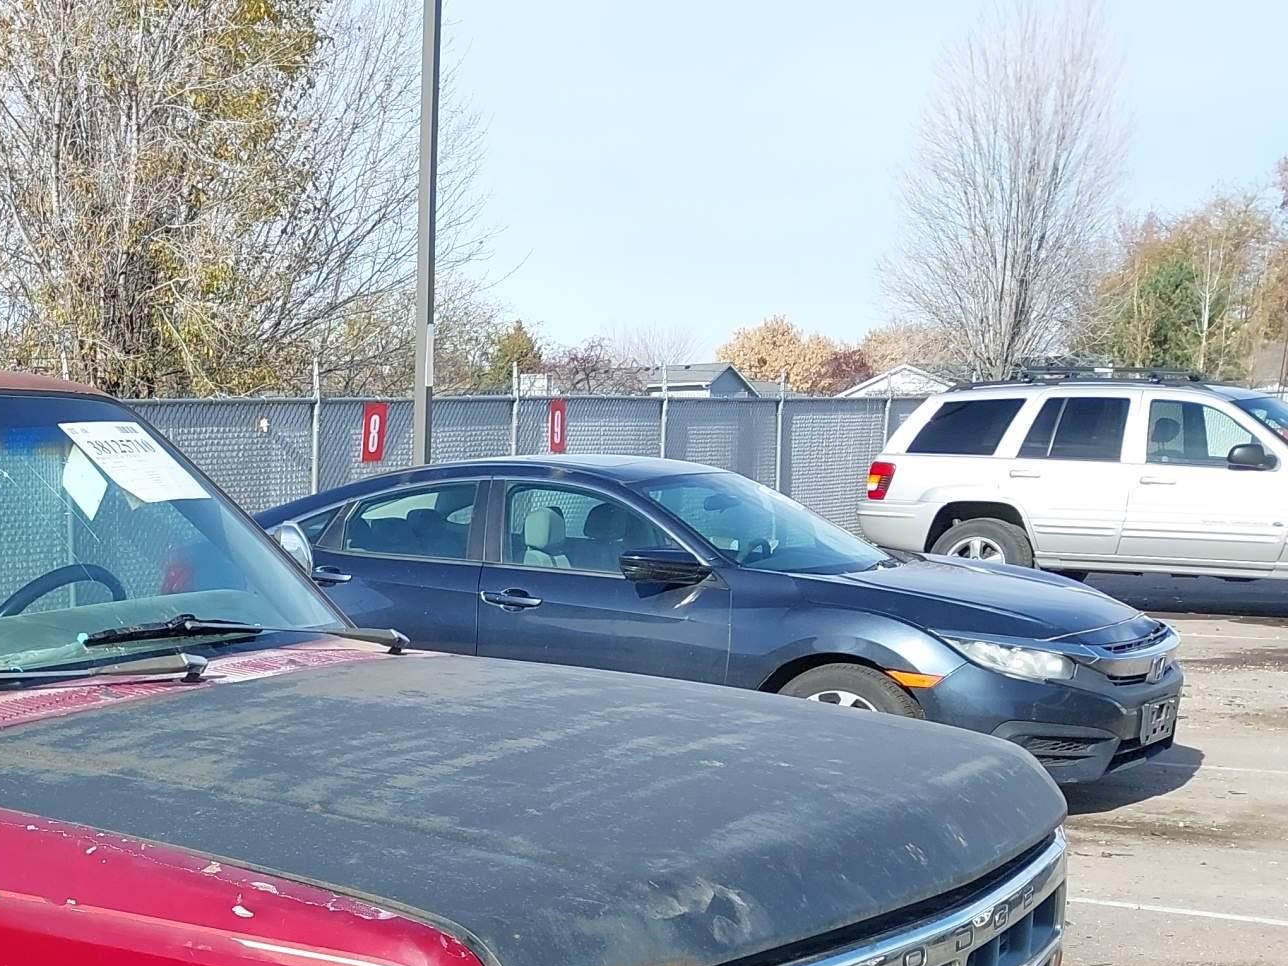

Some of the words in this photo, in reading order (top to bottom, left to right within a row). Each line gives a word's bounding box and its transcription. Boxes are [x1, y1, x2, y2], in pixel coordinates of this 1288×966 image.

[368, 413, 381, 453] 8
[554, 410, 562, 444] 9
[86, 438, 156, 456] 38125710
